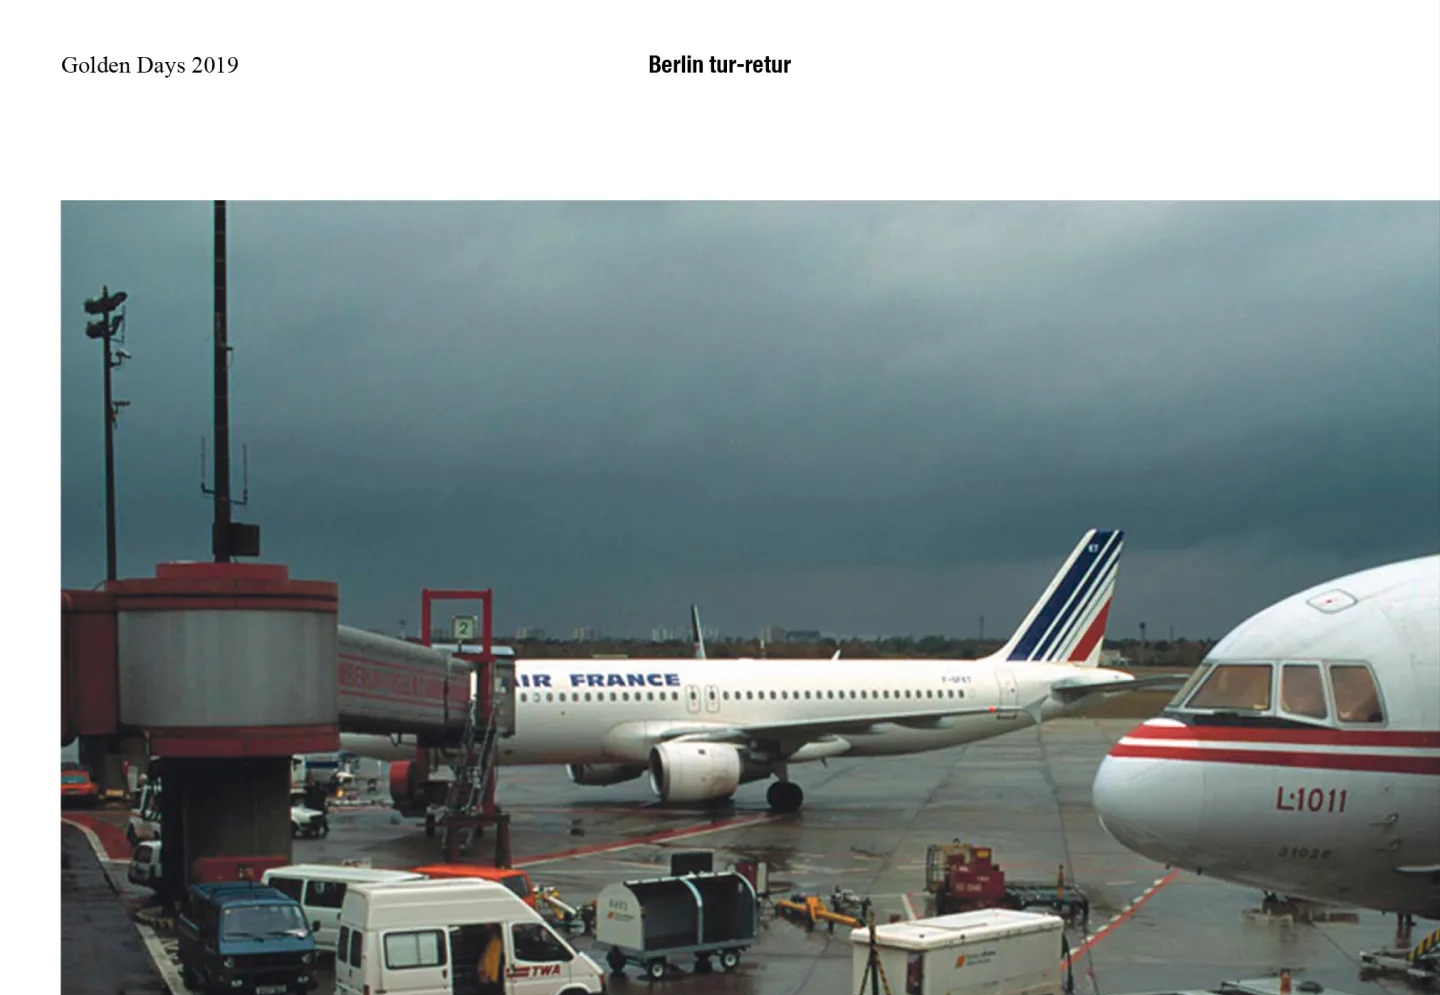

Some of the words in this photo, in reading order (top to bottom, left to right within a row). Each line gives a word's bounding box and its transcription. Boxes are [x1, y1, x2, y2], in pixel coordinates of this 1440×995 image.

[61, 55, 132, 74] Golden
[136, 56, 186, 79] Days
[191, 56, 239, 74] 2019
[649, 54, 704, 74] Berlin
[708, 55, 792, 74] tur-retur
[459, 622, 468, 634] 2
[569, 673, 681, 687] FRANCE
[530, 964, 562, 977] TWA
